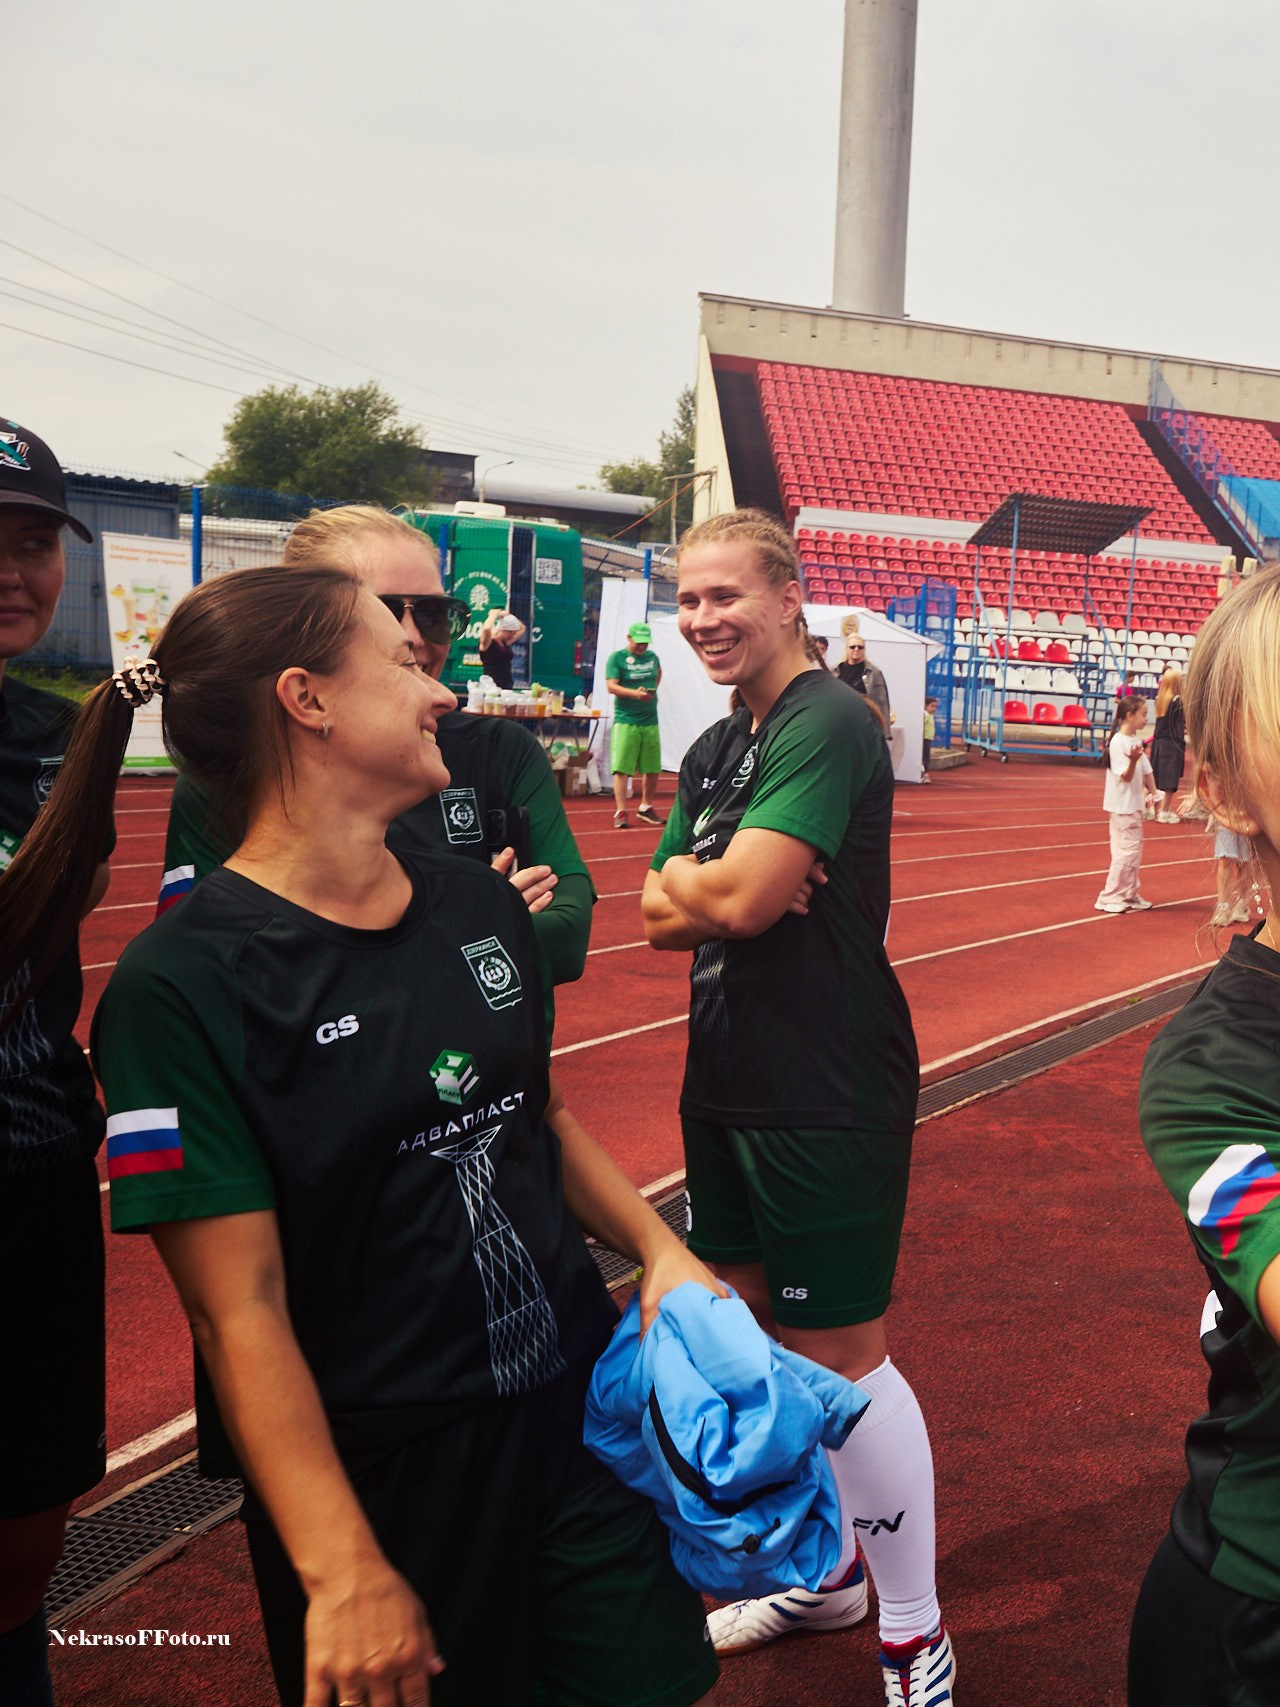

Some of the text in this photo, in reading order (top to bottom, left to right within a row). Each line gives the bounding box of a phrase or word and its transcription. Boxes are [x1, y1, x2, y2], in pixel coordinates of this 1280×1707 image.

[315, 1014, 360, 1045] GS
[397, 1091, 525, 1155] АДВАПЛАСТ
[782, 1286, 808, 1300] GS
